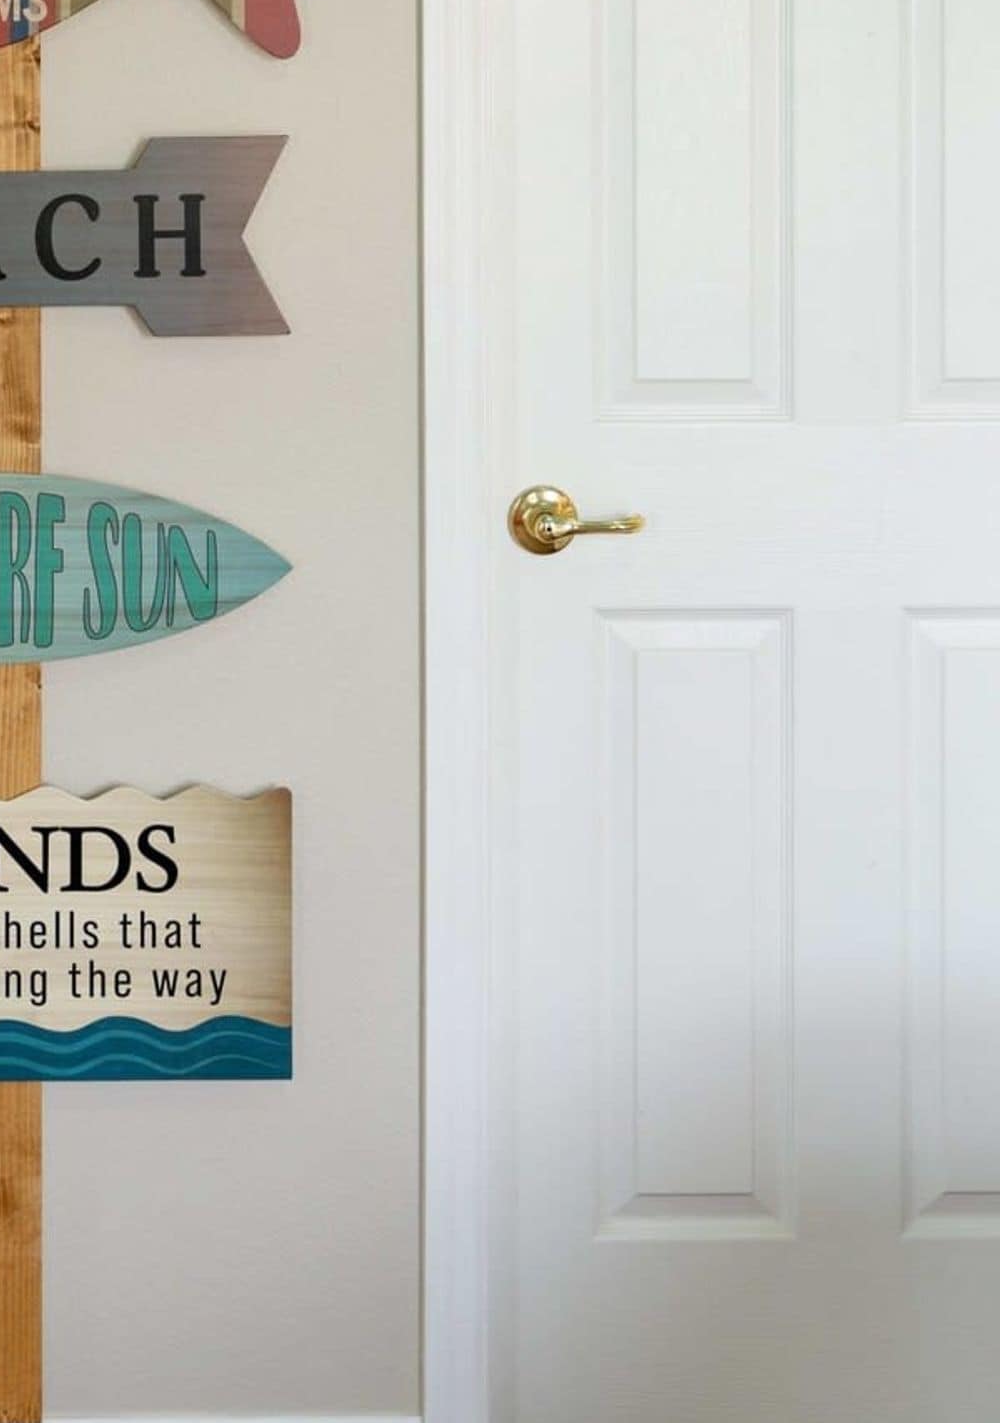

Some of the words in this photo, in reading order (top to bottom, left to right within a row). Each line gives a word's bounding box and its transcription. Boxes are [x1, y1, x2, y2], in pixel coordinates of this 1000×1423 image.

[83, 502, 217, 640] SUN
[120, 912, 201, 949] that
[68, 962, 132, 999] the
[152, 968, 228, 1004] way
